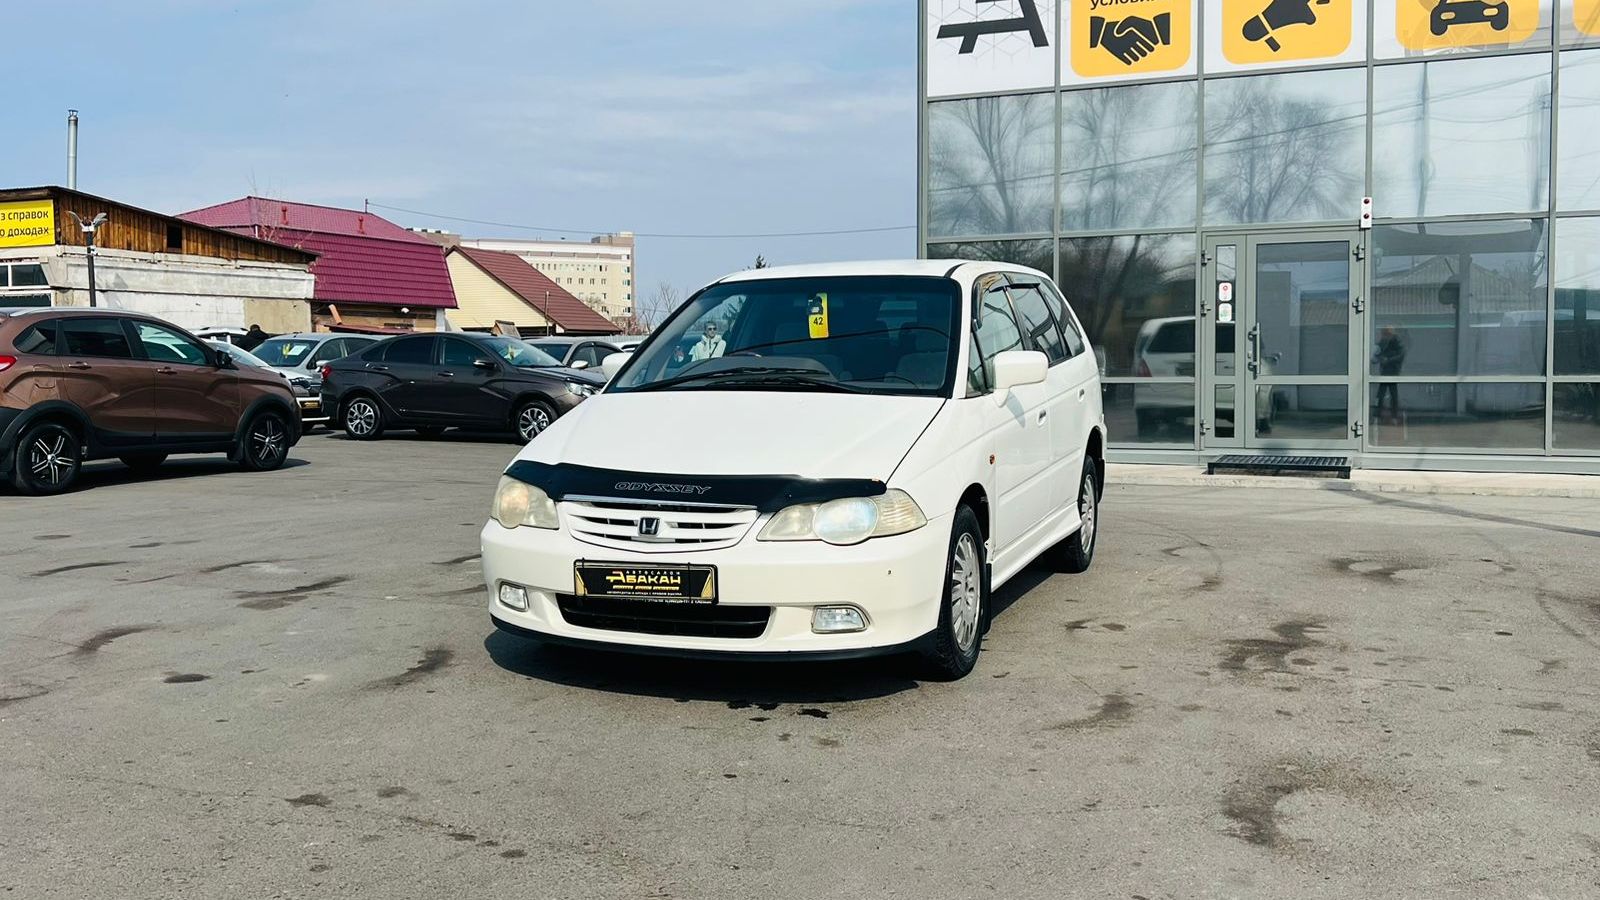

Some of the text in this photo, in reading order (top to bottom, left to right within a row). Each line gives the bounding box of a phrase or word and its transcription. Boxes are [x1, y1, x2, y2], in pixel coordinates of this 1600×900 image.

[8, 211, 49, 222] справок
[8, 227, 49, 238] доходах
[813, 317, 824, 325] 42
[615, 481, 712, 495] ODYSSEY
